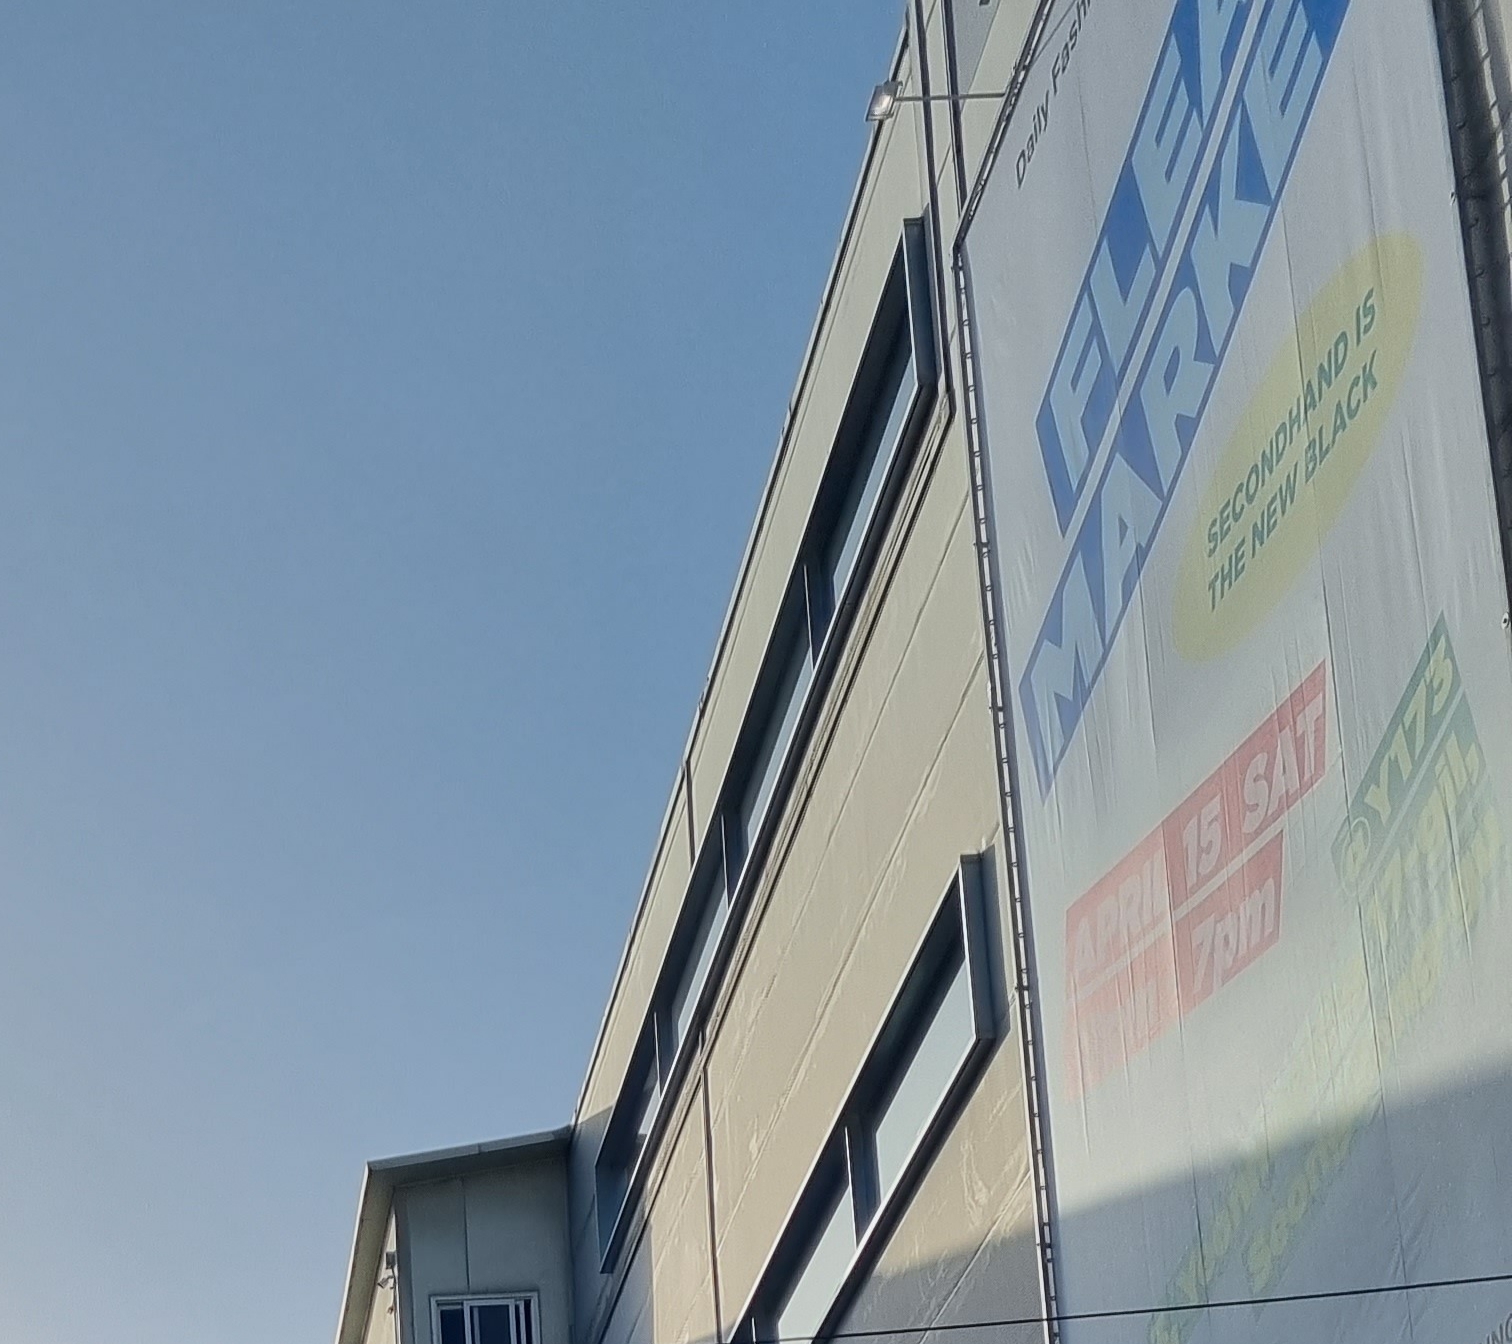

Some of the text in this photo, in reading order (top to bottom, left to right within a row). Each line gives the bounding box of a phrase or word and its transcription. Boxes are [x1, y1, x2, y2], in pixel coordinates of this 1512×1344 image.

[1016, 0, 1091, 189] Daily Fash
[1207, 287, 1376, 558] SECONDHAND IS
[1207, 349, 1378, 612] THE NEW BLACK
[1181, 799, 1222, 884] 15
[1242, 691, 1324, 835] SAT
